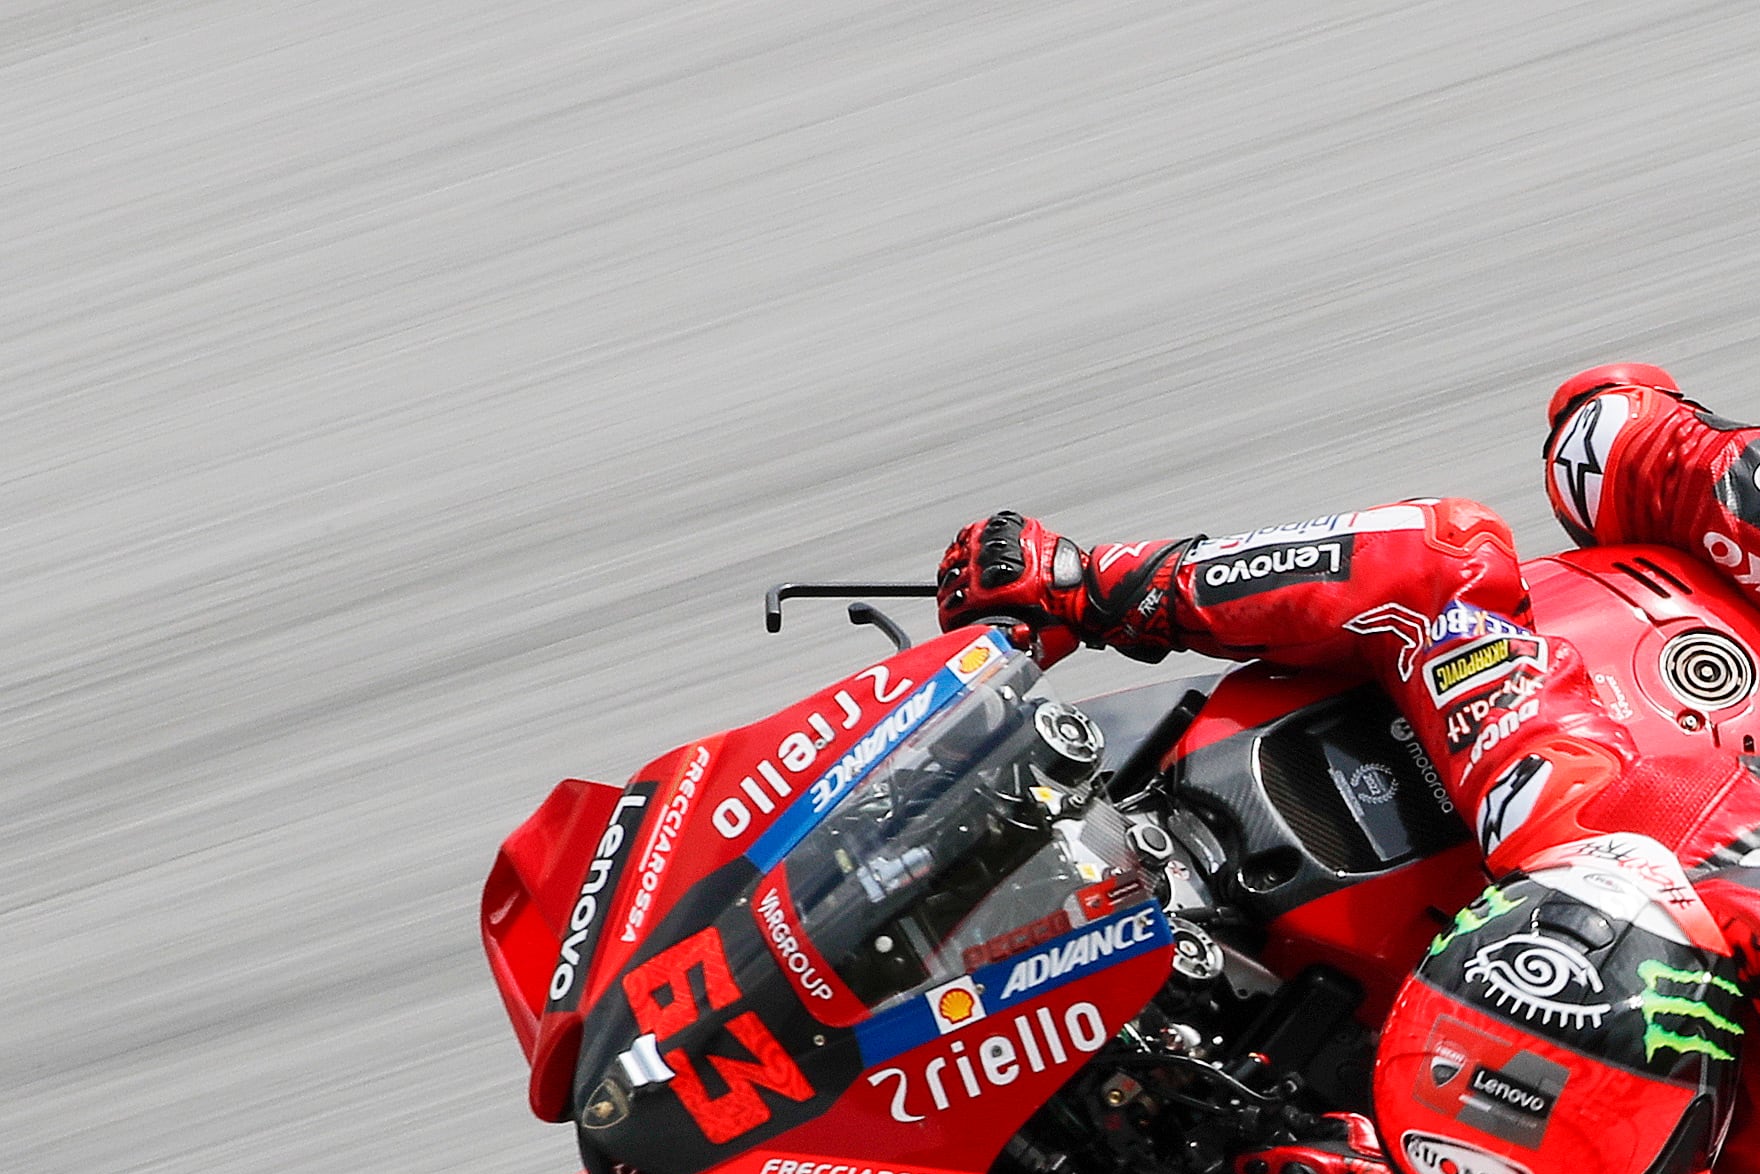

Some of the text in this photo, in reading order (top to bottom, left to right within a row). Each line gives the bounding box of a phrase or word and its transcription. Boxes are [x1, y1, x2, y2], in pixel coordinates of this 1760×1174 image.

[1205, 540, 1342, 588] Lenovo
[711, 688, 865, 841] riello
[810, 679, 940, 815] ADVANCE
[1404, 738, 1456, 815] motorola
[548, 794, 648, 1002] Lenovo
[620, 744, 711, 944] FRECCIAROSSA
[755, 887, 836, 1002] VARGROUP
[1000, 906, 1156, 1000] ADVANCE
[620, 926, 818, 1146] 63
[924, 1000, 1108, 1111] riello
[1472, 1068, 1546, 1113] Lenovo
